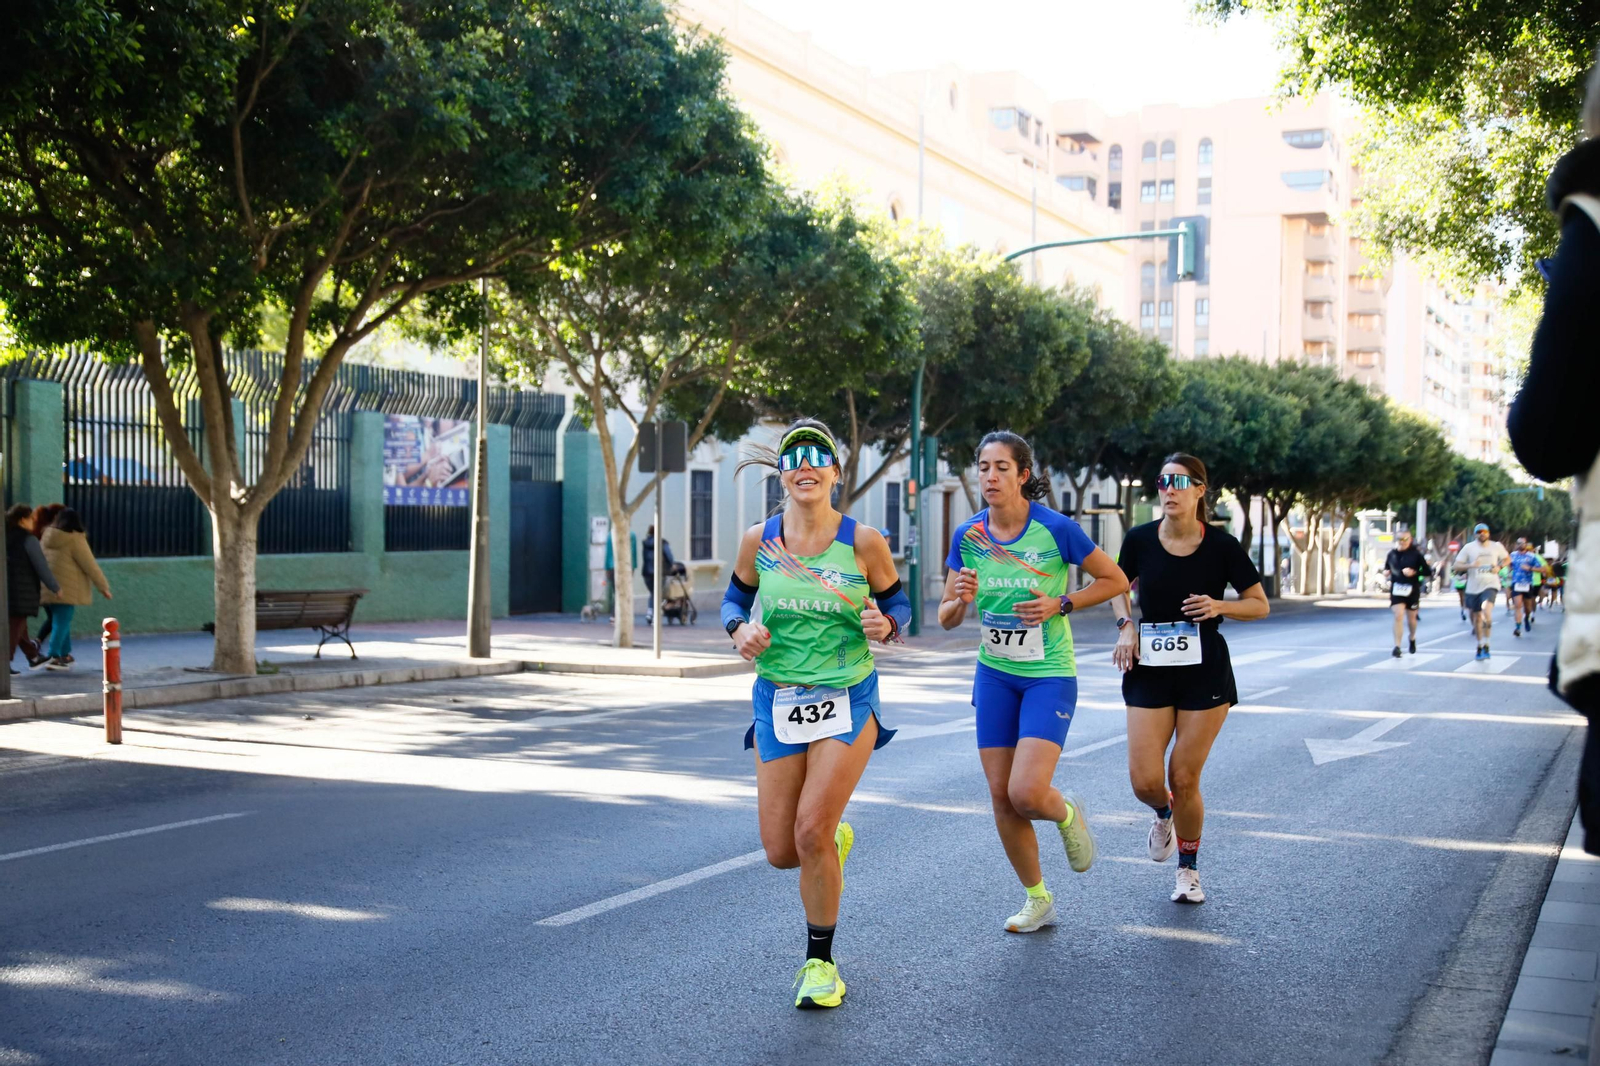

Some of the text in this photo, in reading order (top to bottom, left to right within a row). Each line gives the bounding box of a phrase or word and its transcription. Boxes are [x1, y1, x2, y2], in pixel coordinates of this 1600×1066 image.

[987, 577, 1039, 588] SAKATA
[777, 598, 842, 614] SAKATA
[990, 629, 1027, 646] 377
[1151, 636, 1189, 651] 665
[788, 700, 836, 725] 432
